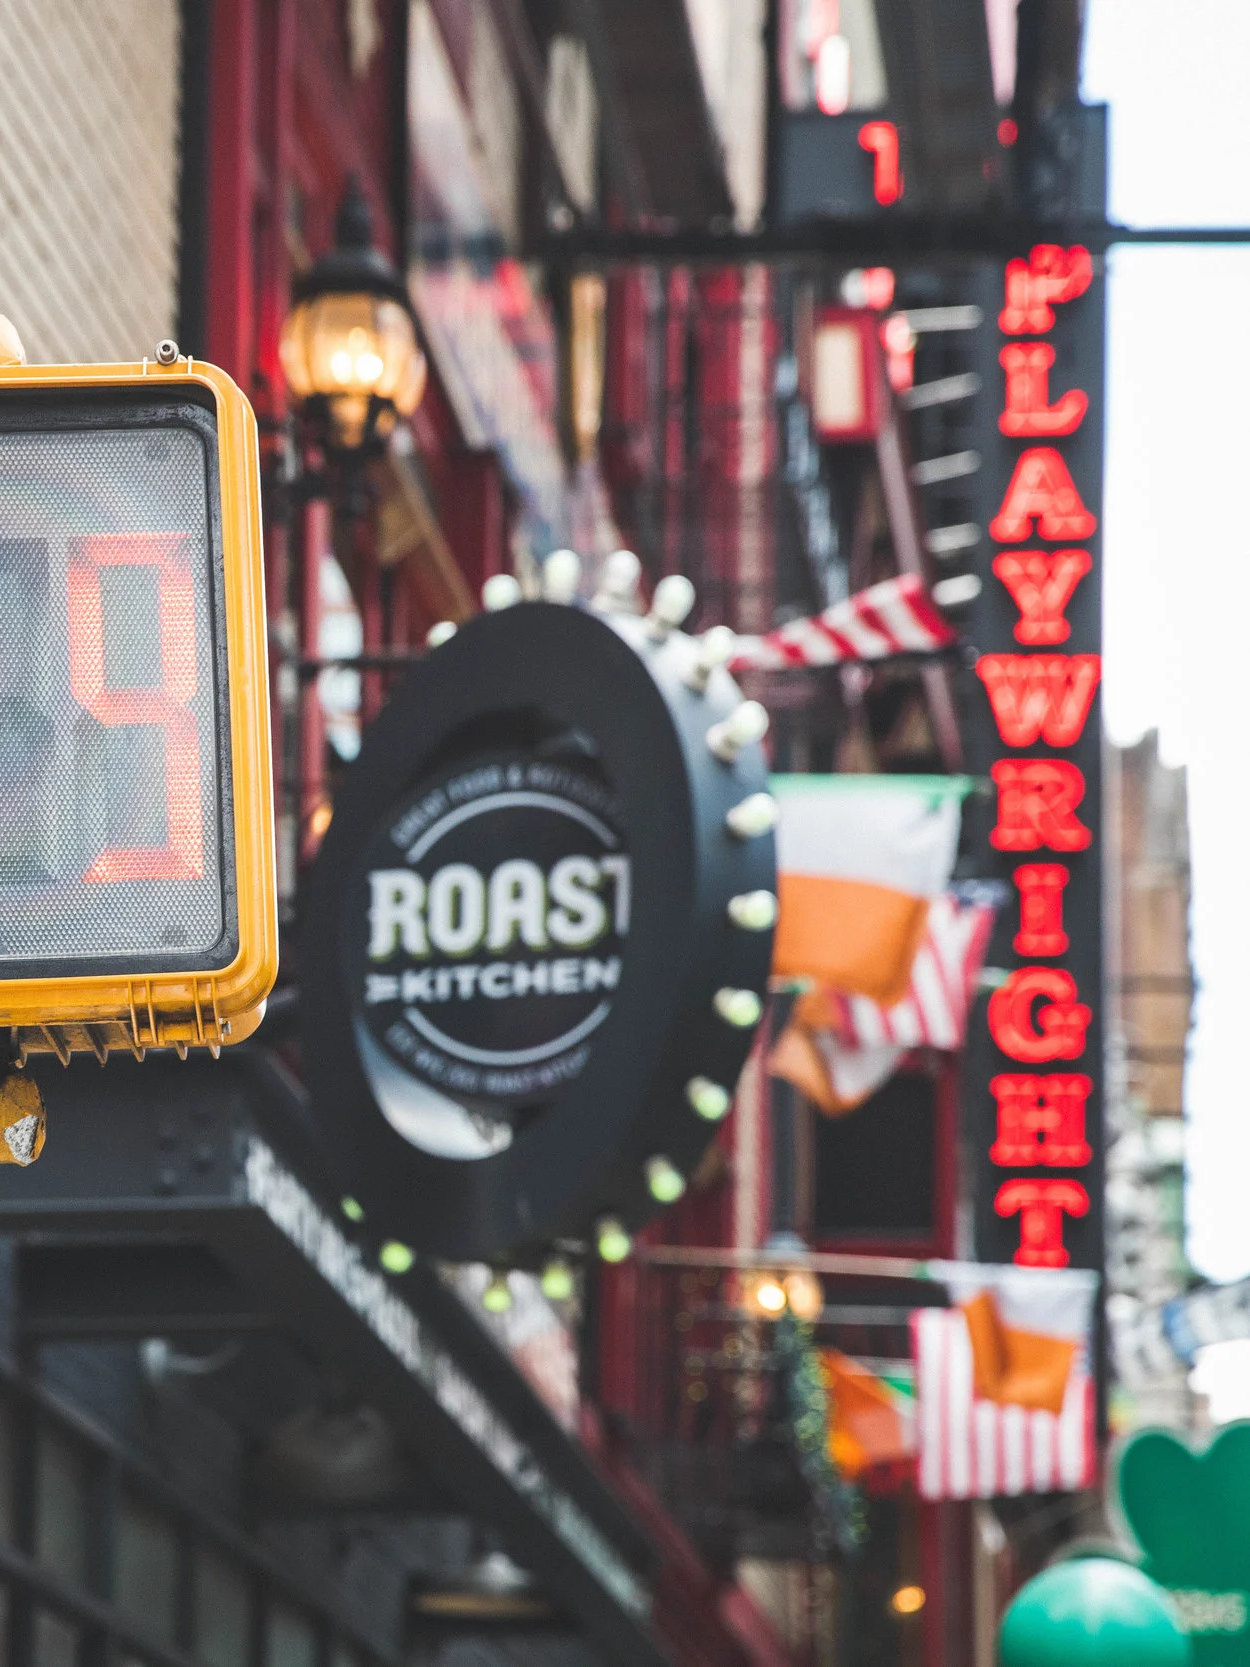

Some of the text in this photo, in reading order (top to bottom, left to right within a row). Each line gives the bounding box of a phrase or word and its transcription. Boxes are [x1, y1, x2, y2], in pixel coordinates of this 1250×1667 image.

[66, 530, 204, 884] 9
[976, 243, 1102, 1267] PLAYWRIGHT
[367, 854, 632, 961] ROAST
[401, 955, 622, 1004] KITCHEN
